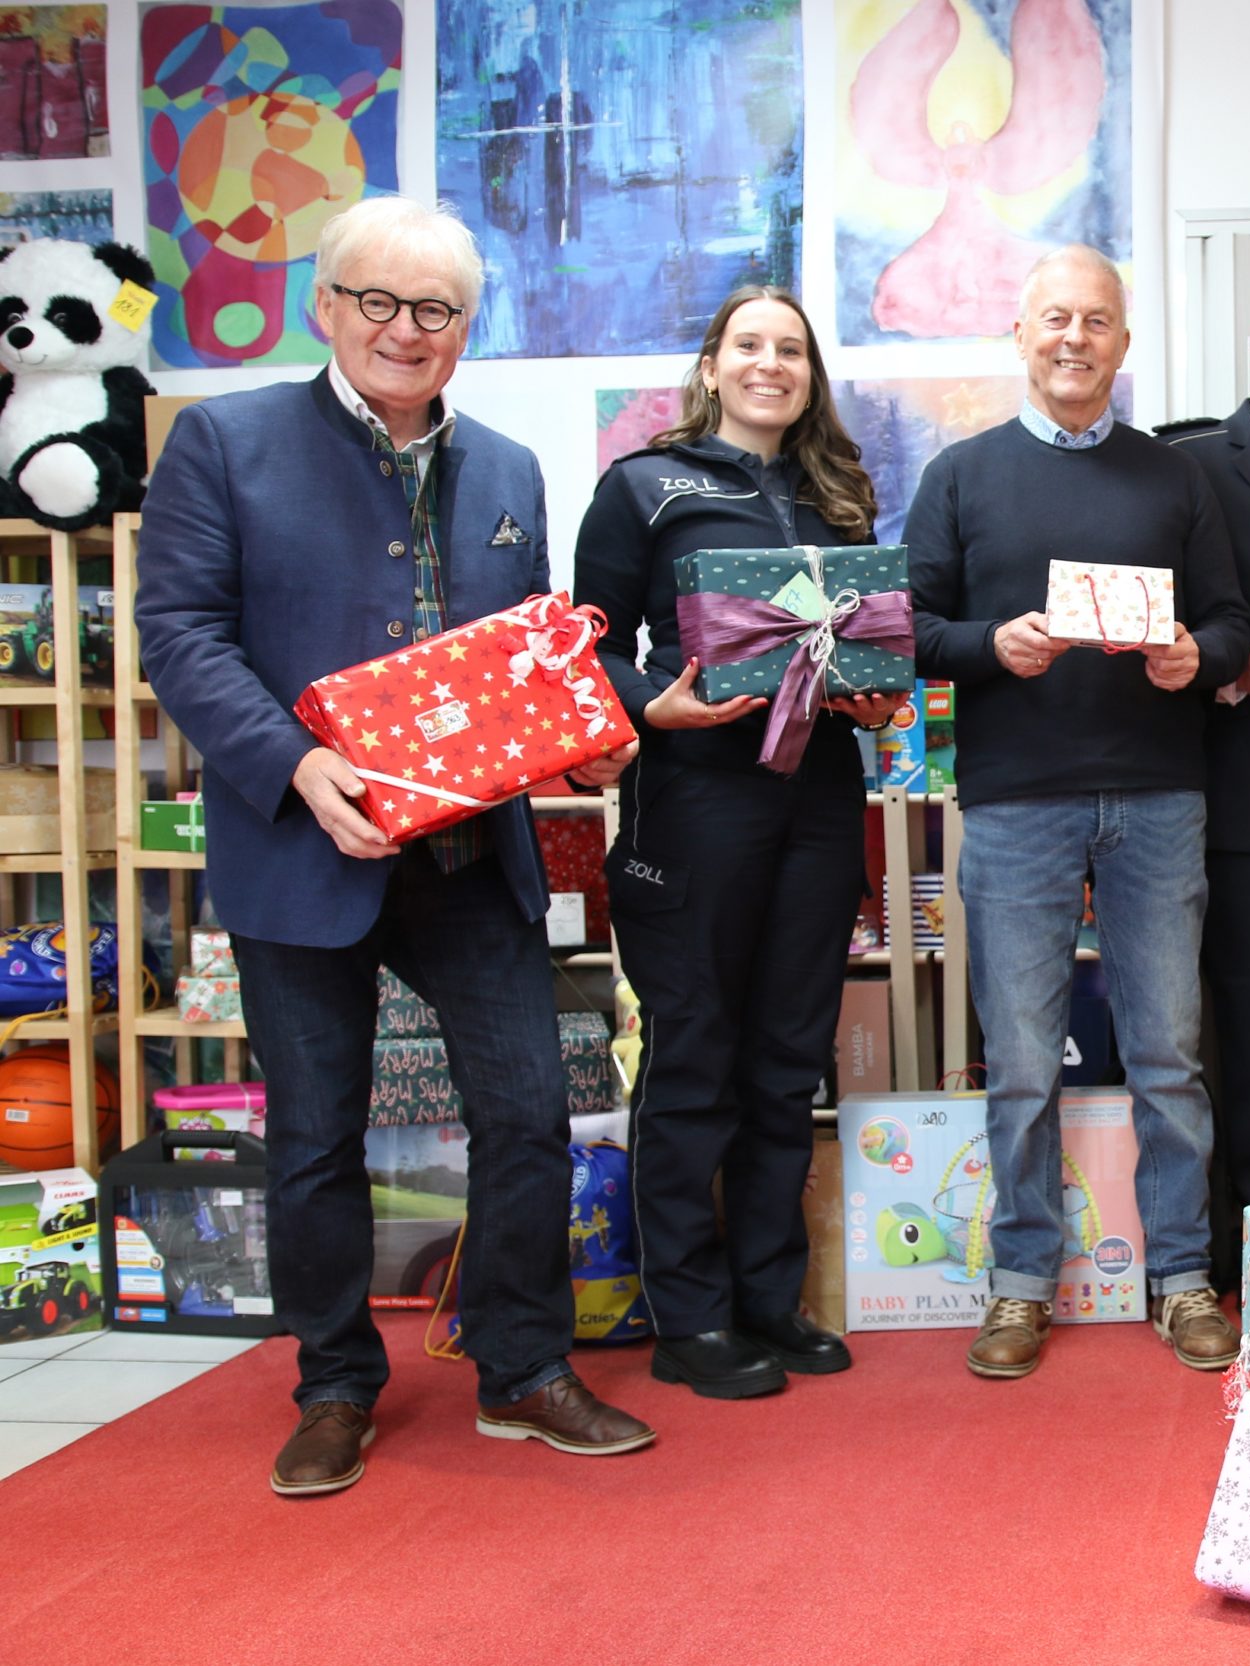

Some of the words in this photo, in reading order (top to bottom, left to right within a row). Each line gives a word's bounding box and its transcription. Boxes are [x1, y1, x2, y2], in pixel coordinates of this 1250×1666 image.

[659, 478, 718, 491] ZOLL
[929, 699, 948, 709] LEGO
[624, 859, 664, 885] ZOLL
[852, 1023, 864, 1076] BAMBA
[379, 1048, 434, 1075] MERRY
[860, 1296, 908, 1311] BABY
[915, 1294, 960, 1309] PLAY
[861, 1314, 906, 1325] JOURNEY
[908, 1313, 921, 1323] OF
[924, 1312, 980, 1322] DISCOVERY
